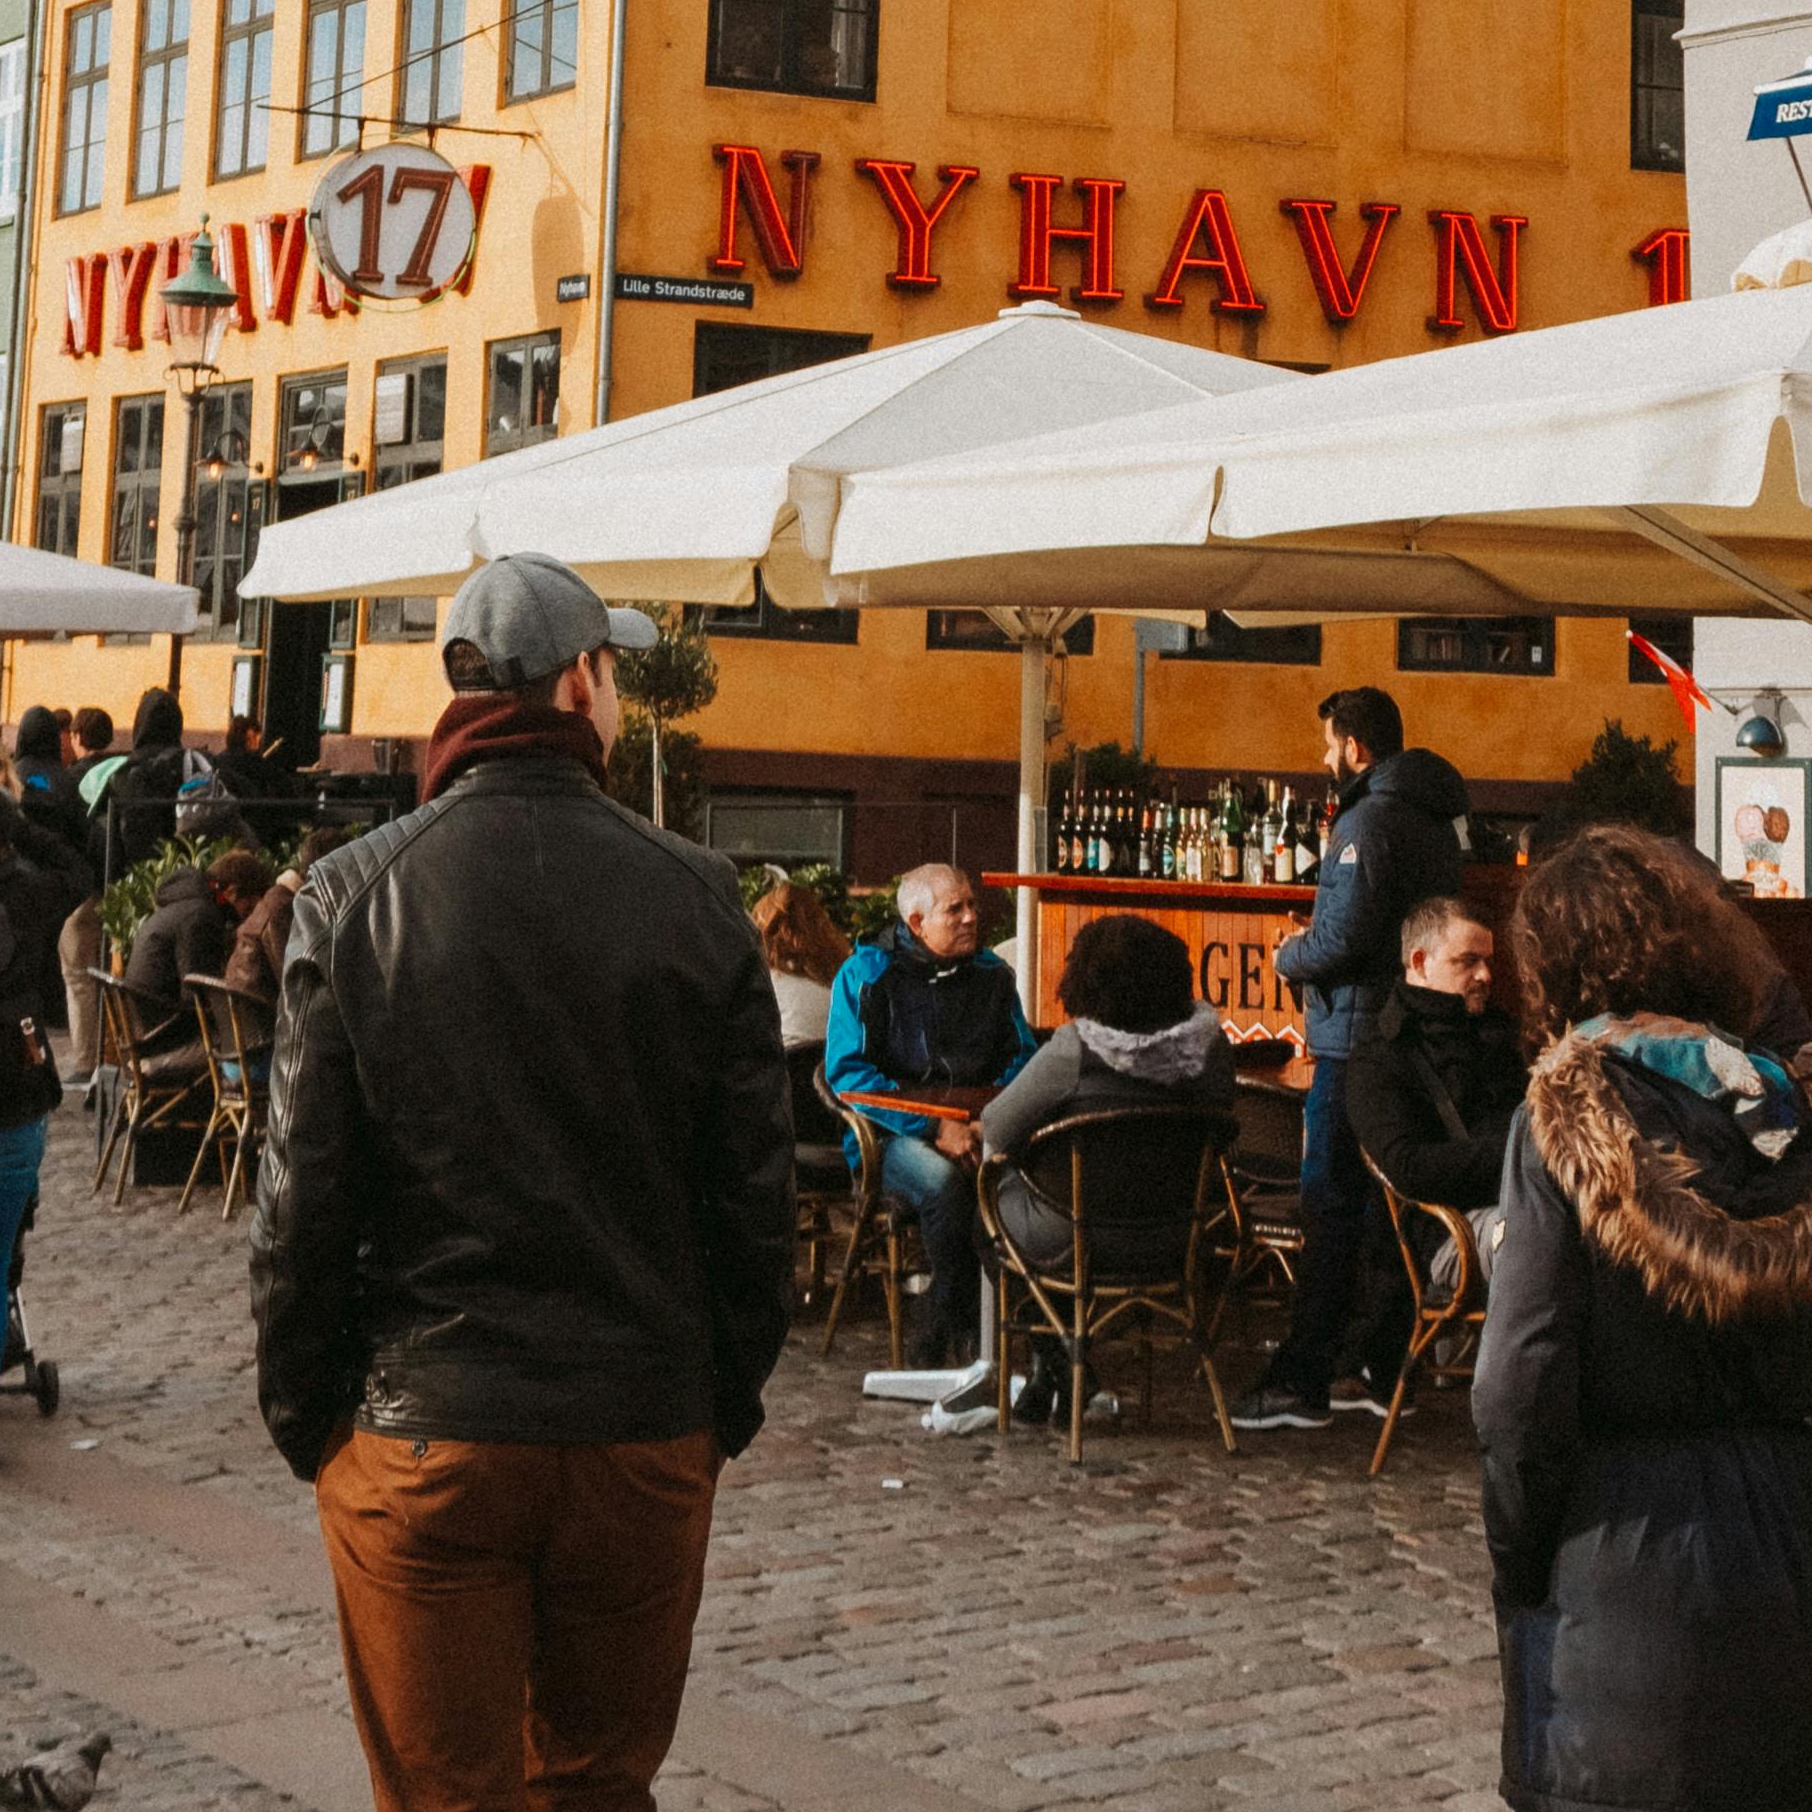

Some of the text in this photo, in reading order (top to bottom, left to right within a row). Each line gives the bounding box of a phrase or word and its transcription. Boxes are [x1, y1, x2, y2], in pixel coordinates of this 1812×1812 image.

[61, 208, 361, 358] NYHAV
[336, 164, 458, 287] 17
[623, 279, 745, 301] Lille Strandstræde
[707, 143, 1690, 335] NYHAVN 1
